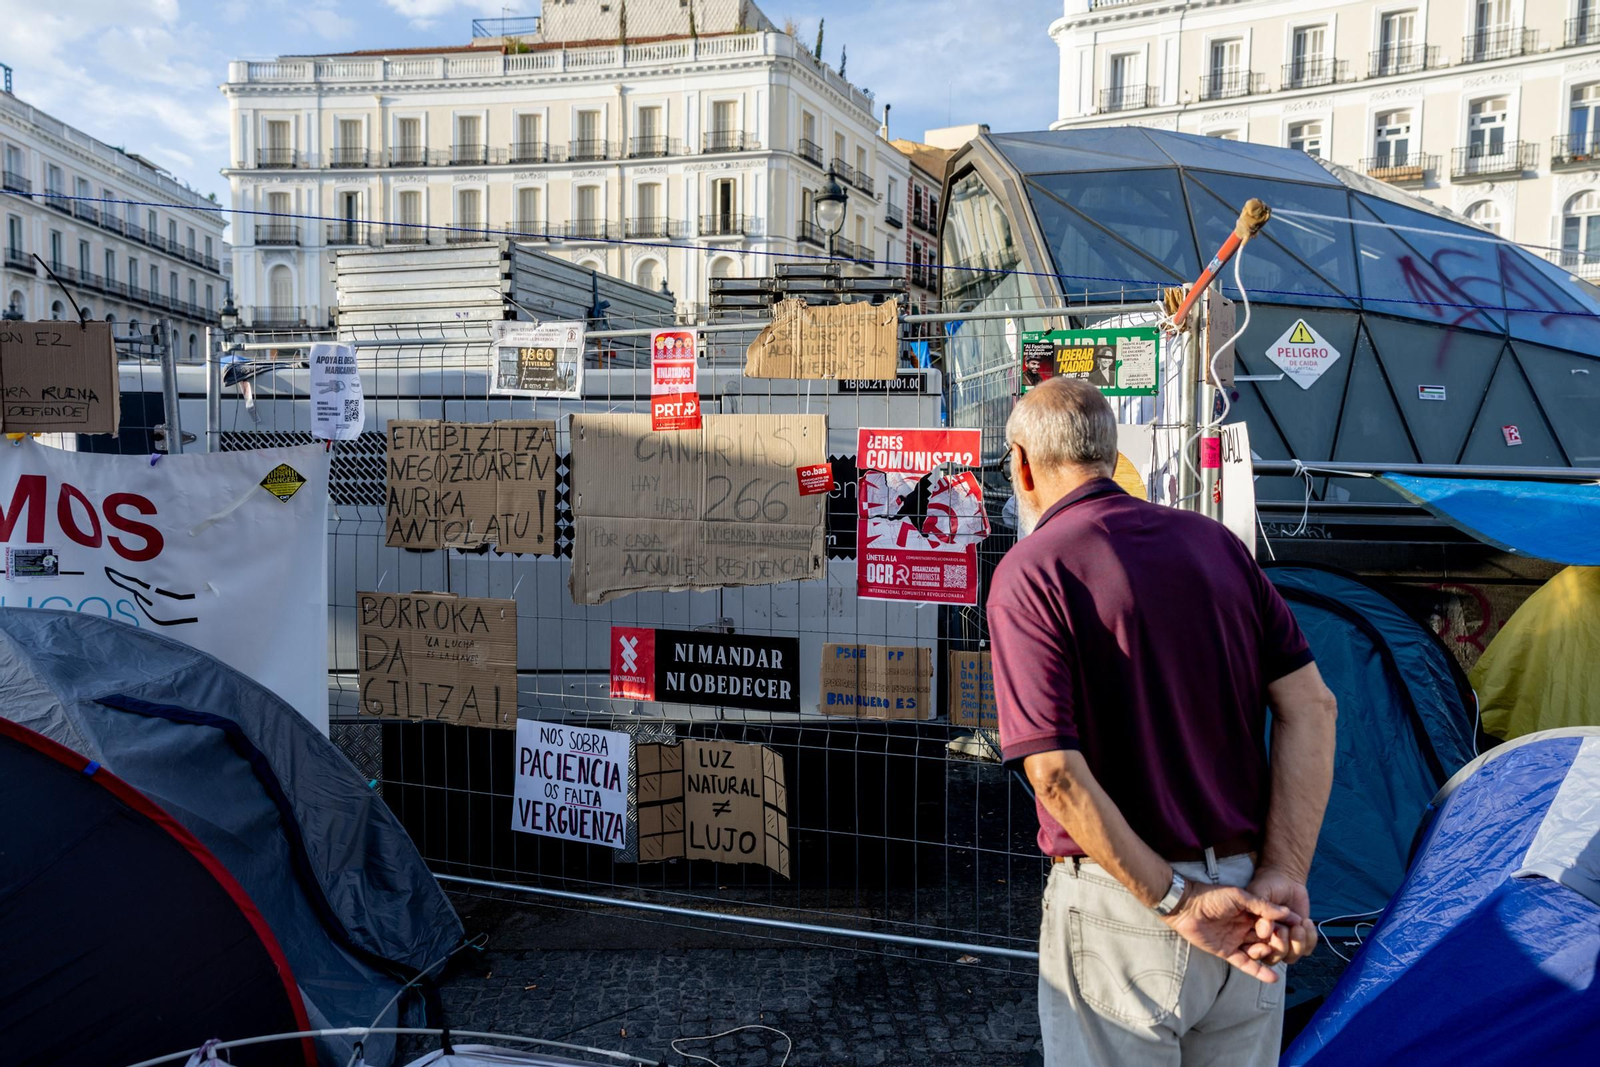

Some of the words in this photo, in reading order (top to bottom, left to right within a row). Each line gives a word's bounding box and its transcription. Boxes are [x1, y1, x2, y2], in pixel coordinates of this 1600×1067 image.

[316, 356, 337, 364] APOYA
[1056, 348, 1094, 362] LIBERAR
[1277, 347, 1329, 359] PELIGRO
[1058, 360, 1094, 373] MADRID
[7, 405, 85, 417] DEFIENDE
[390, 426, 556, 451] ETXEBIZITZA
[635, 426, 797, 468] CANARIAS
[866, 435, 904, 451] ¿ERES
[390, 452, 551, 483] NEGOZIOAREN
[866, 449, 974, 472] COMUNISTA?
[801, 467, 828, 477] co.bas
[630, 475, 661, 492] HAY
[388, 486, 466, 518] AURKA
[702, 475, 790, 522] 266
[624, 531, 664, 547] CADA
[622, 553, 709, 578] ALQUILER
[866, 553, 885, 562] ÚNETE
[866, 563, 894, 584] OCR
[911, 565, 941, 573] ORGANIZACIÓN
[911, 573, 941, 581] COMUNISTA
[867, 588, 901, 596] INTERNACIONAL
[926, 591, 965, 599] REVOLUCIONARIA
[361, 596, 490, 634] BORROKA
[444, 637, 475, 649] LUCHA
[364, 634, 409, 677] DA
[675, 643, 694, 663] NI
[698, 643, 783, 670] MANDAR
[612, 674, 647, 684] HORIZONTAL
[666, 672, 685, 692] NI
[689, 672, 792, 700] OBEDECER
[826, 692, 890, 709] BANQUERO
[895, 697, 917, 709] ES
[539, 726, 564, 748] NOS
[568, 731, 609, 754] SOBRA
[699, 747, 735, 769] LUZ
[519, 747, 622, 793] PACIENCIA
[544, 782, 560, 800] OS
[564, 787, 602, 806] FALTA
[688, 773, 761, 798] NATURAL
[518, 798, 625, 846] VERGÜENZA
[689, 820, 757, 854] LUJO
